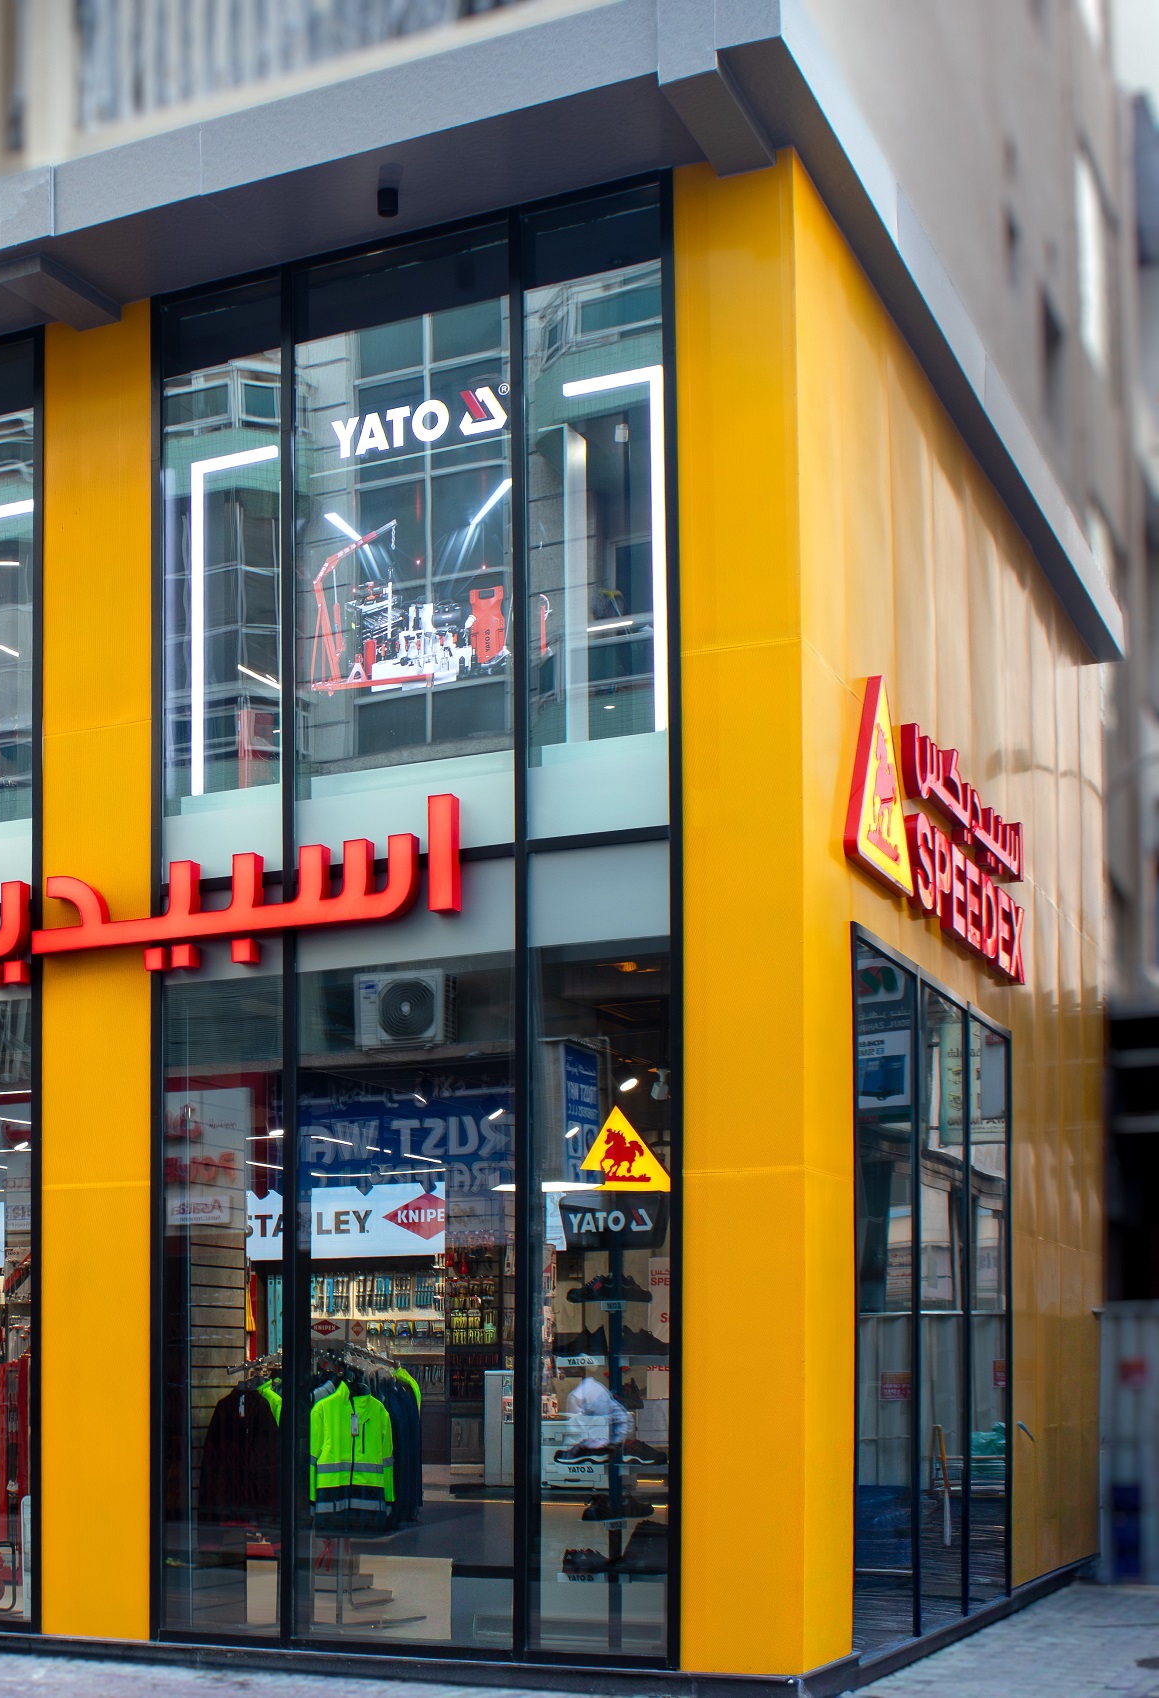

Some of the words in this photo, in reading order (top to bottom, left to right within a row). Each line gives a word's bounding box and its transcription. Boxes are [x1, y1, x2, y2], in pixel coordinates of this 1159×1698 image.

[331, 400, 450, 458] YATO
[905, 812, 1026, 985] SPEEDEX
[569, 1211, 625, 1233] YATO
